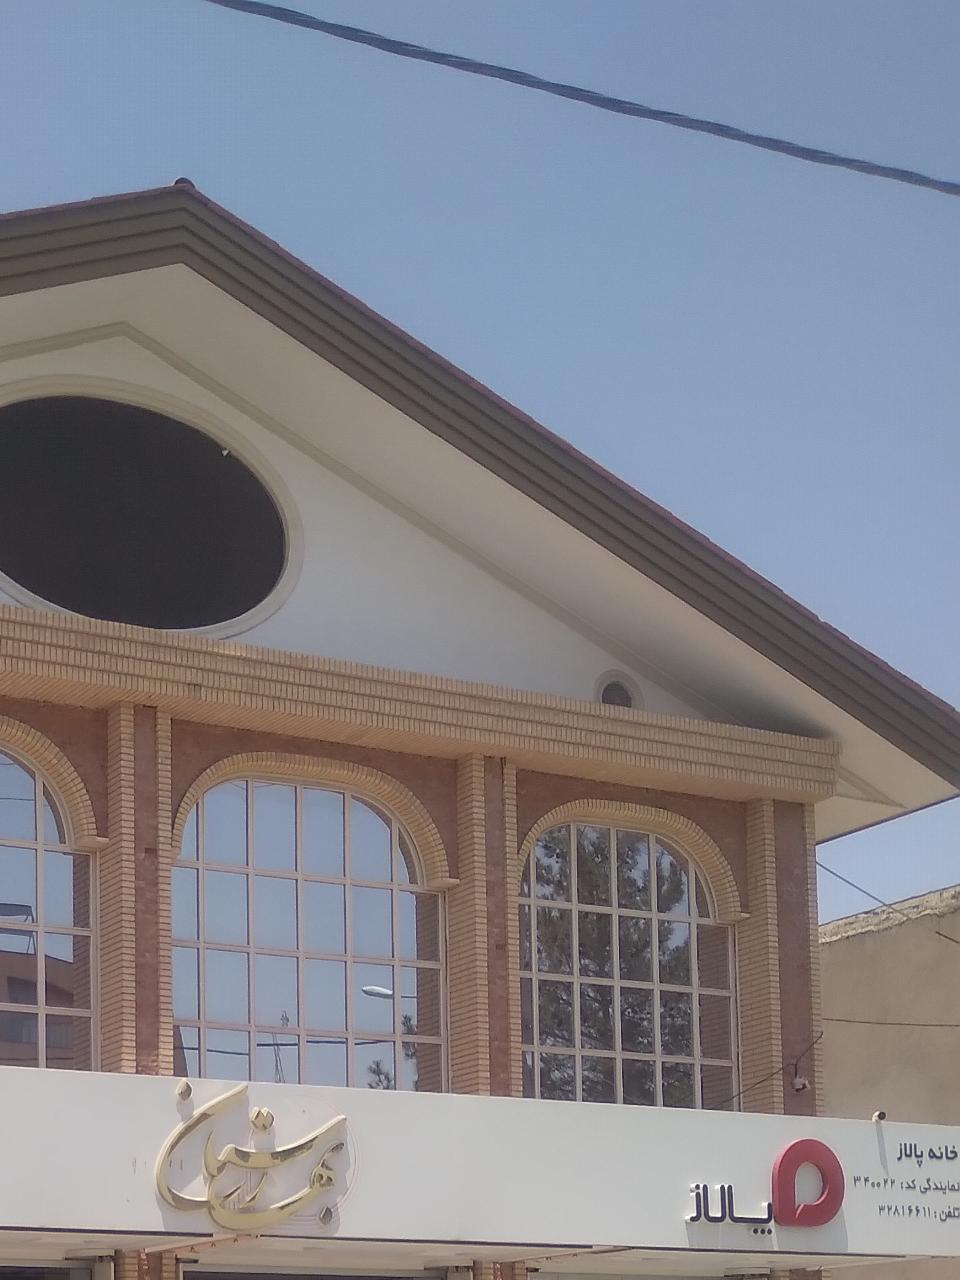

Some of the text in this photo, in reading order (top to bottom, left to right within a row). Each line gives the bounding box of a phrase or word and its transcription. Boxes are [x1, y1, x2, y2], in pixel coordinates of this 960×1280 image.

[897, 1142, 959, 1168] خانه پالاز
[687, 1184, 773, 1236] پالاز
